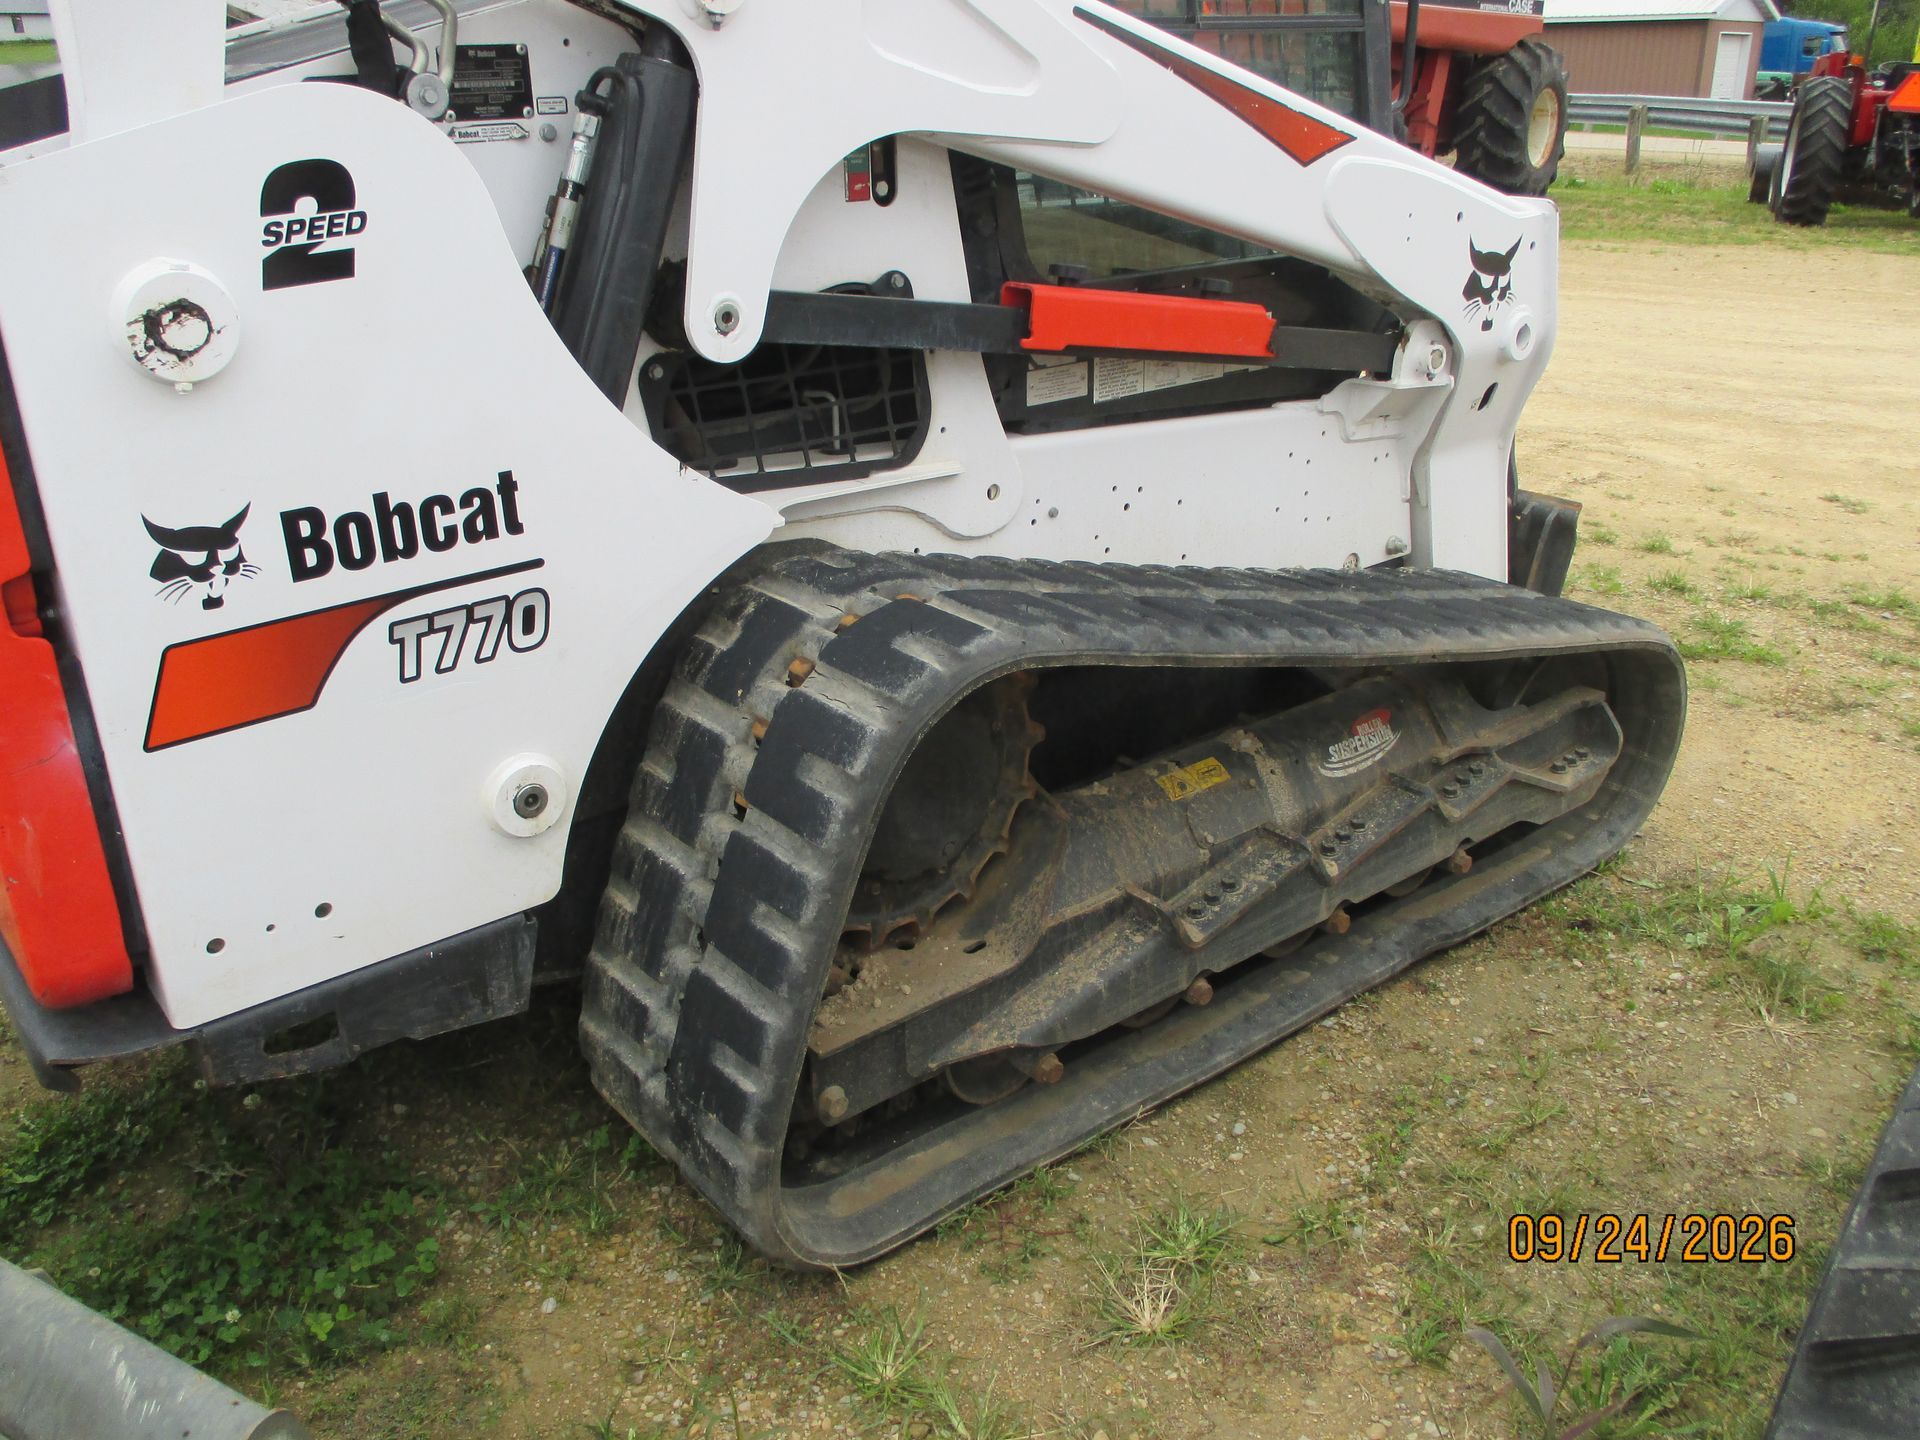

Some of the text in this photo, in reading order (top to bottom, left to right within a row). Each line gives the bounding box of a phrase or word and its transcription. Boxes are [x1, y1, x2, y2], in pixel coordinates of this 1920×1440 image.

[1508, 0, 1533, 14] CASE
[477, 50, 496, 58] Bobcat
[458, 130, 480, 139] Bobcat
[261, 159, 356, 291] 2
[261, 210, 367, 248] SPEED
[280, 471, 524, 583] Bobcat
[388, 587, 550, 684] T770
[1329, 725, 1393, 762] SUSPENSION
[1356, 718, 1382, 737] ROLLER
